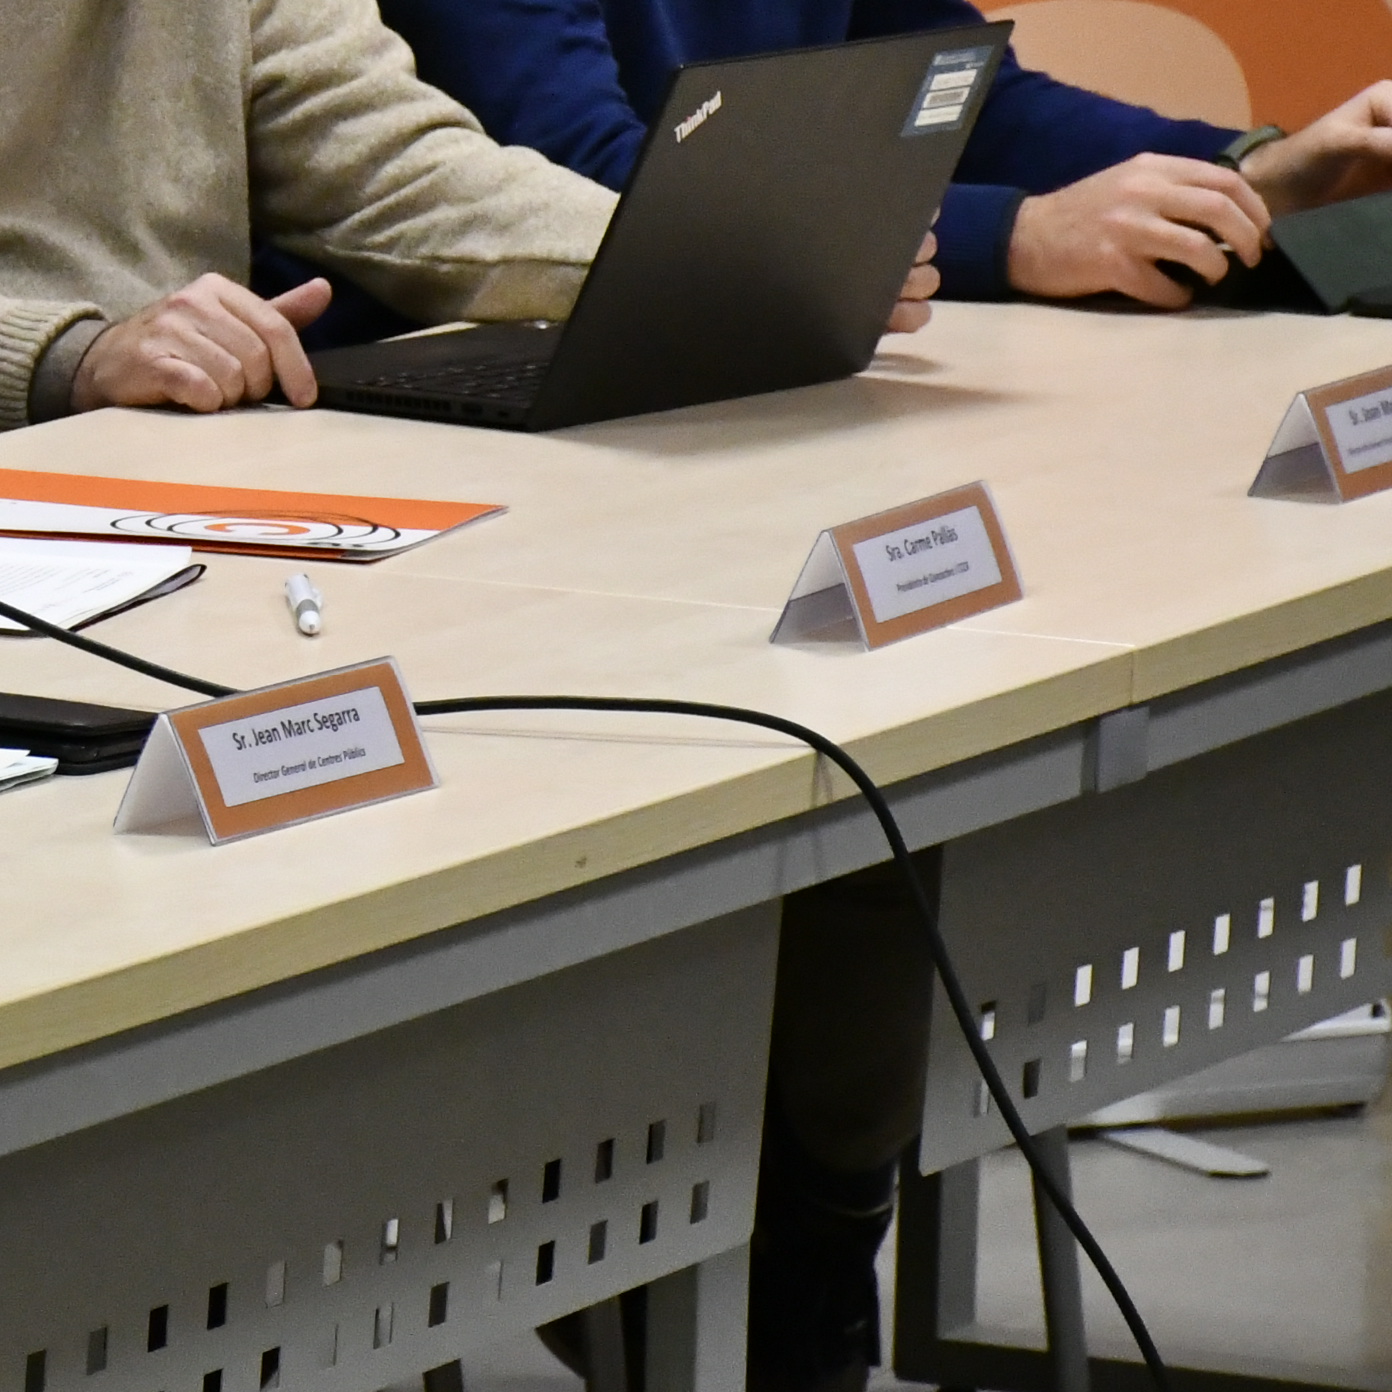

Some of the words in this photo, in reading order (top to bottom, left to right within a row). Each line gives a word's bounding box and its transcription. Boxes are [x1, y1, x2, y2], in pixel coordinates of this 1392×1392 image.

[232, 732, 252, 751] Sr.
[252, 727, 281, 746] Jean
[280, 719, 315, 739] Marc
[313, 708, 360, 732] Segarra
